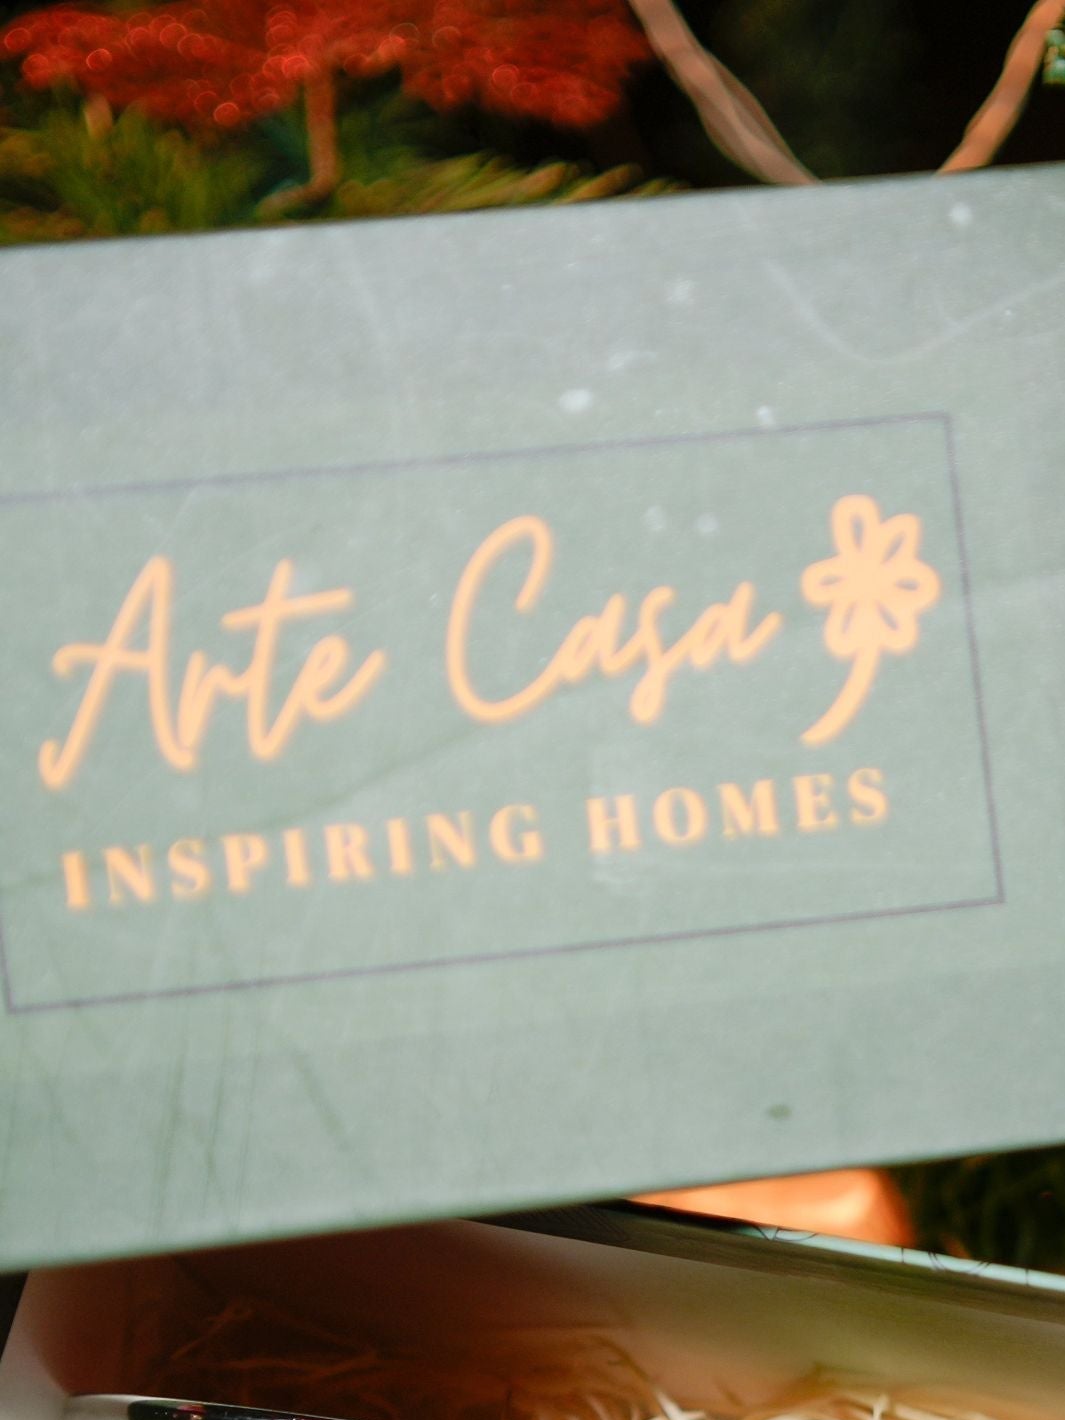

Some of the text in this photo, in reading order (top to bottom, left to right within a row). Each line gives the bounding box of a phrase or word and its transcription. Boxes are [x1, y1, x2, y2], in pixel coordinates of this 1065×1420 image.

[38, 514, 784, 791] Arte Casa
[60, 766, 891, 911] INSPIRING HOMES
